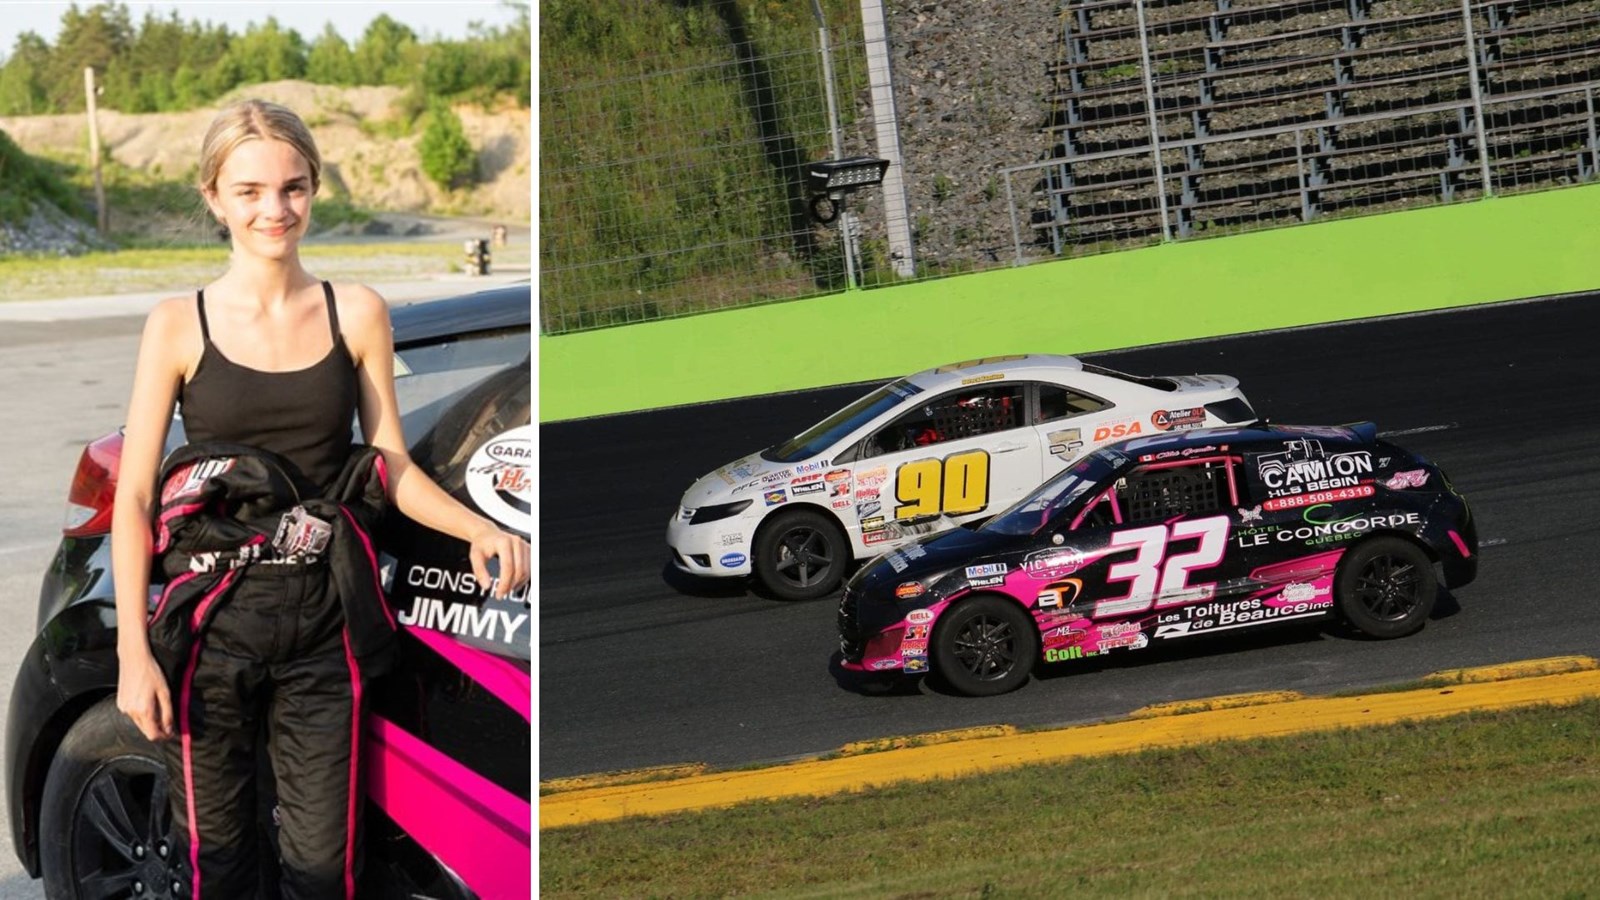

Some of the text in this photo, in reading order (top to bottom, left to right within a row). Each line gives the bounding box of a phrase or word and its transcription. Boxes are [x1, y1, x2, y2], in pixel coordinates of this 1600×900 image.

[1093, 422, 1142, 441] DSA
[790, 473, 823, 485] ARP
[796, 462, 820, 474] Mobil
[1264, 455, 1373, 488] CAMION
[894, 448, 990, 525] 90
[1266, 486, 1372, 509] 1-888-508-4319
[1239, 512, 1421, 548] LE CONCORDE
[968, 566, 995, 576] Mobil
[1093, 514, 1230, 618] 32
[397, 596, 528, 645] JIMMY
[910, 612, 930, 621] BELL
[1158, 598, 1261, 623] Les Toitures
[1192, 618, 1214, 629] de
[1219, 601, 1311, 625] Beauce
[1045, 646, 1083, 662] Colt
